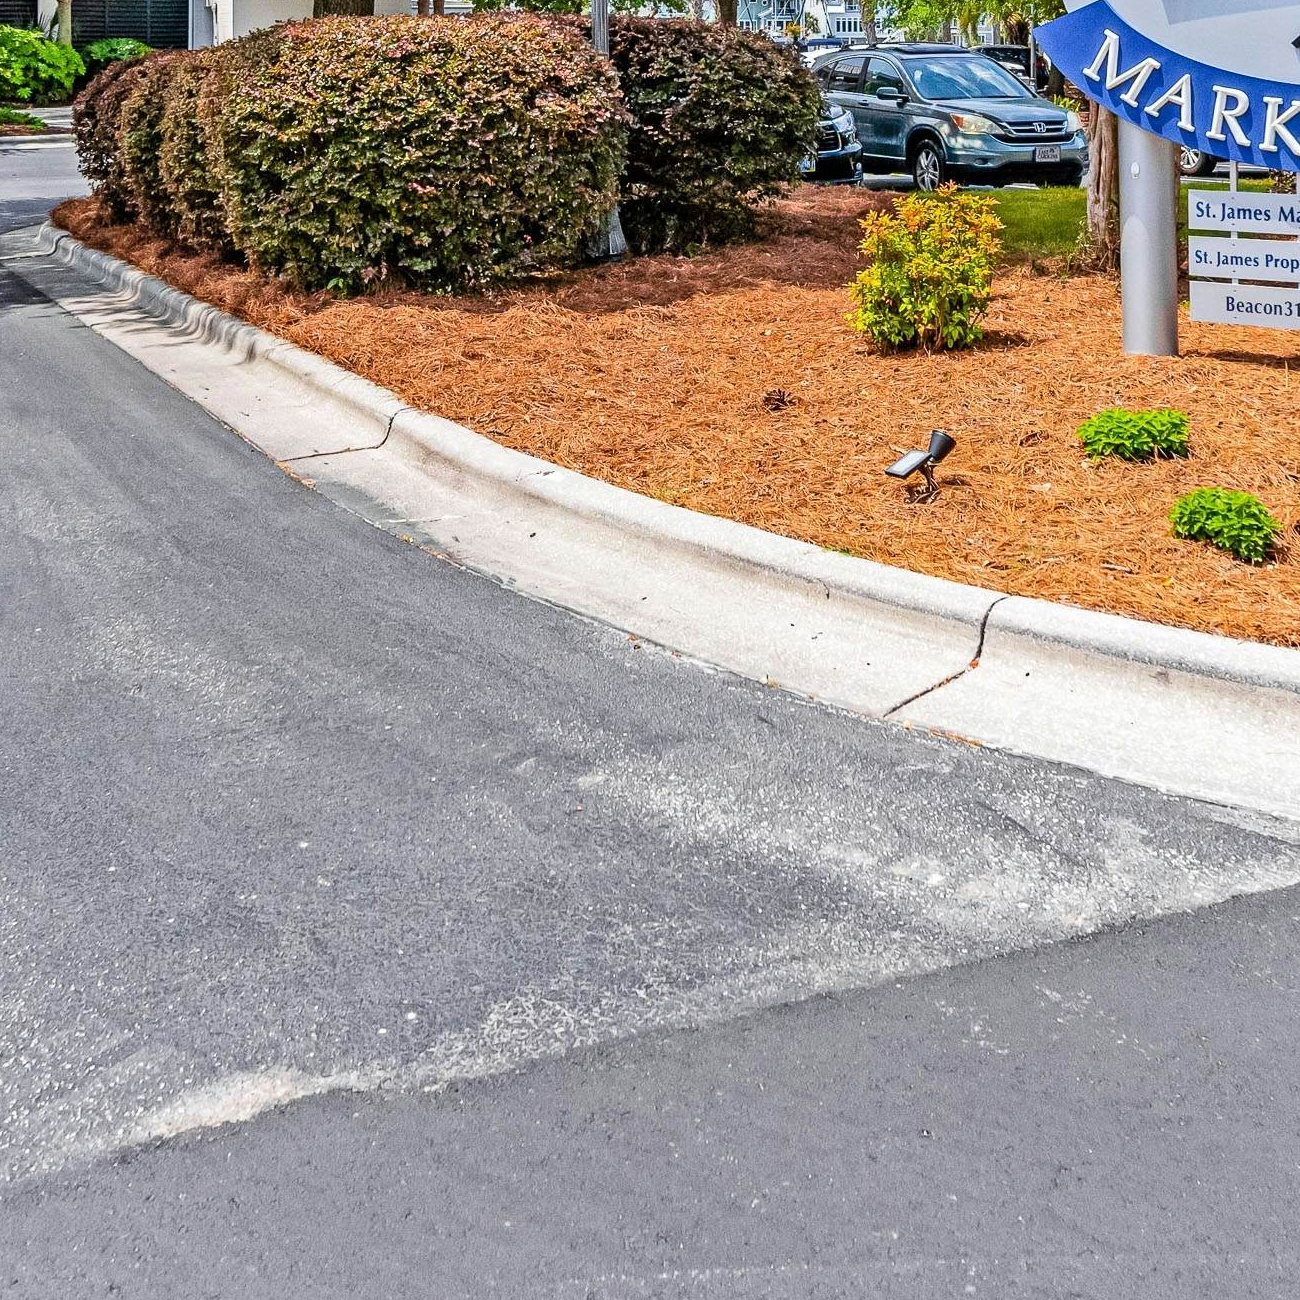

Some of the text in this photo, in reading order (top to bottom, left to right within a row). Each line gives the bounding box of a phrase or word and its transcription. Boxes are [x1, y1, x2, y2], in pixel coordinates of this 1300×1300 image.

[1196, 201, 1216, 218] St.
[1220, 203, 1271, 221] James
[1195, 249, 1213, 264] St.
[1216, 251, 1259, 267] James
